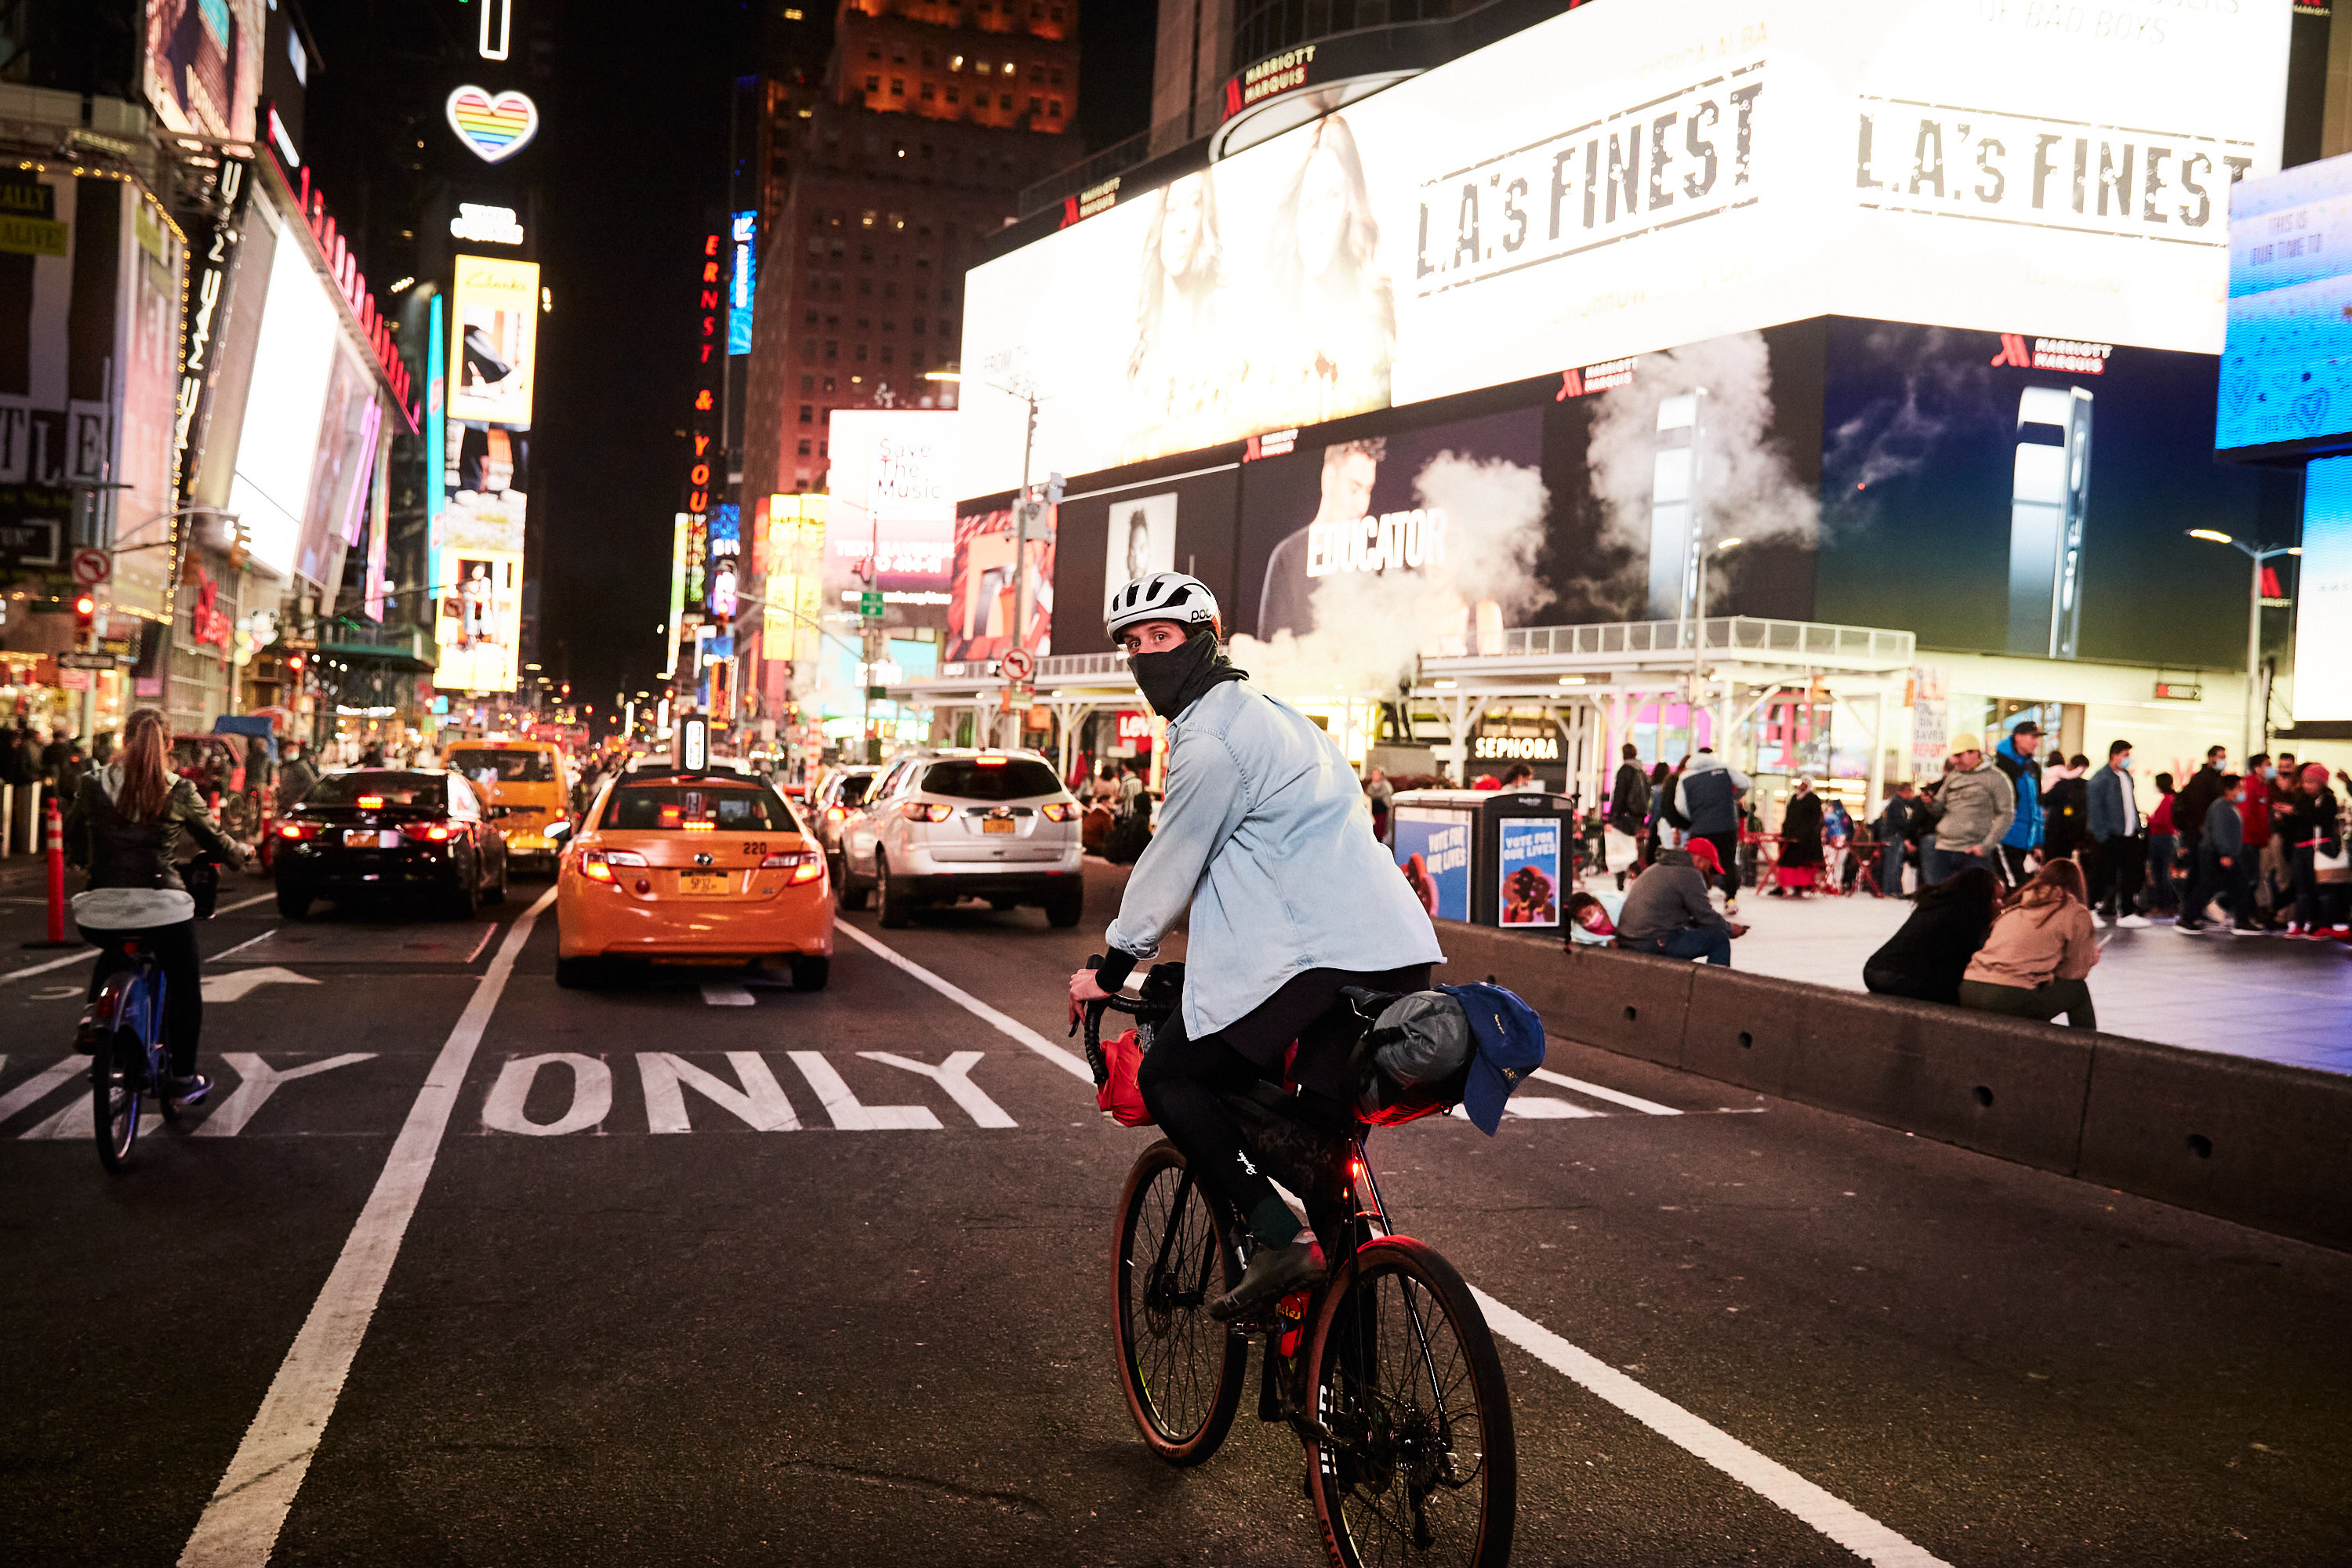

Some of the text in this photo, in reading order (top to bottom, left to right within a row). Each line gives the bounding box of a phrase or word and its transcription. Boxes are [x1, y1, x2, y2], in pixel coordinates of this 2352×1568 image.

[2094, 10, 2169, 45] BOYS
[1245, 45, 1316, 85] MARRIOTT
[1244, 67, 1305, 104] MARQUIS
[1548, 82, 1763, 241] FINEST
[700, 234, 720, 364] ERNST
[2034, 337, 2114, 359] MARRIOTT
[2034, 352, 2103, 373] MARQUIS
[695, 389, 713, 411] &
[880, 437, 931, 458] Save
[879, 456, 919, 478] The
[877, 479, 941, 499] Music
[1306, 507, 1448, 578] EDUCATOR
[1475, 737, 1559, 760] SEPHORA
[743, 841, 768, 855] 220
[1505, 831, 1555, 849] VOTE FOR
[1503, 843, 1556, 860] OUR LIVES
[480, 1051, 1019, 1135] ONLY
